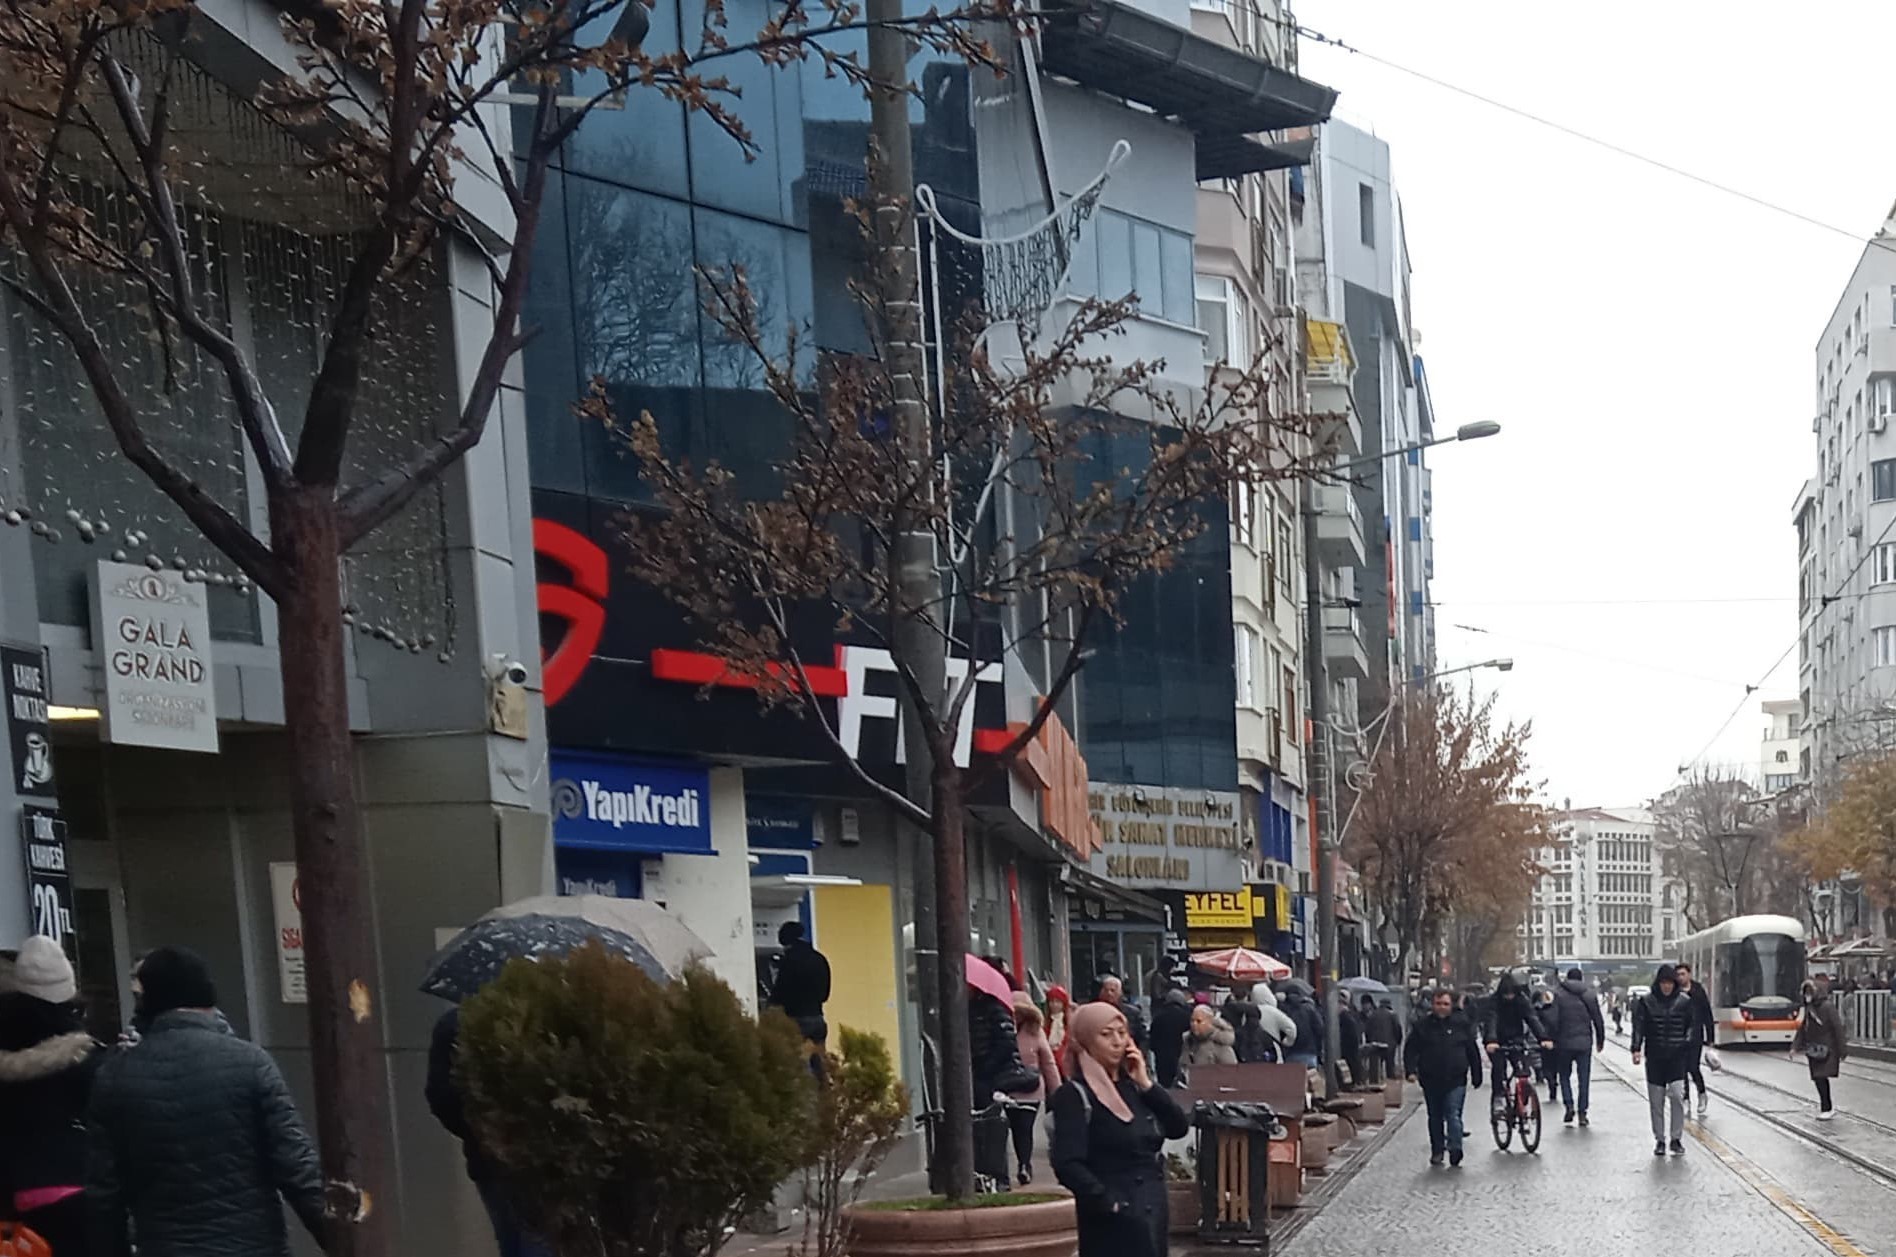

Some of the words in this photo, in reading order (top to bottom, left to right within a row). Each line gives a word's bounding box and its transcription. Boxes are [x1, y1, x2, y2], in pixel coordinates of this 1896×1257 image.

[119, 617, 195, 650] GALA
[112, 651, 207, 684] GRAND
[838, 645, 1003, 768] FT
[581, 780, 699, 829] YapıKredi
[34, 883, 62, 947] 20
[59, 907, 75, 934] TL
